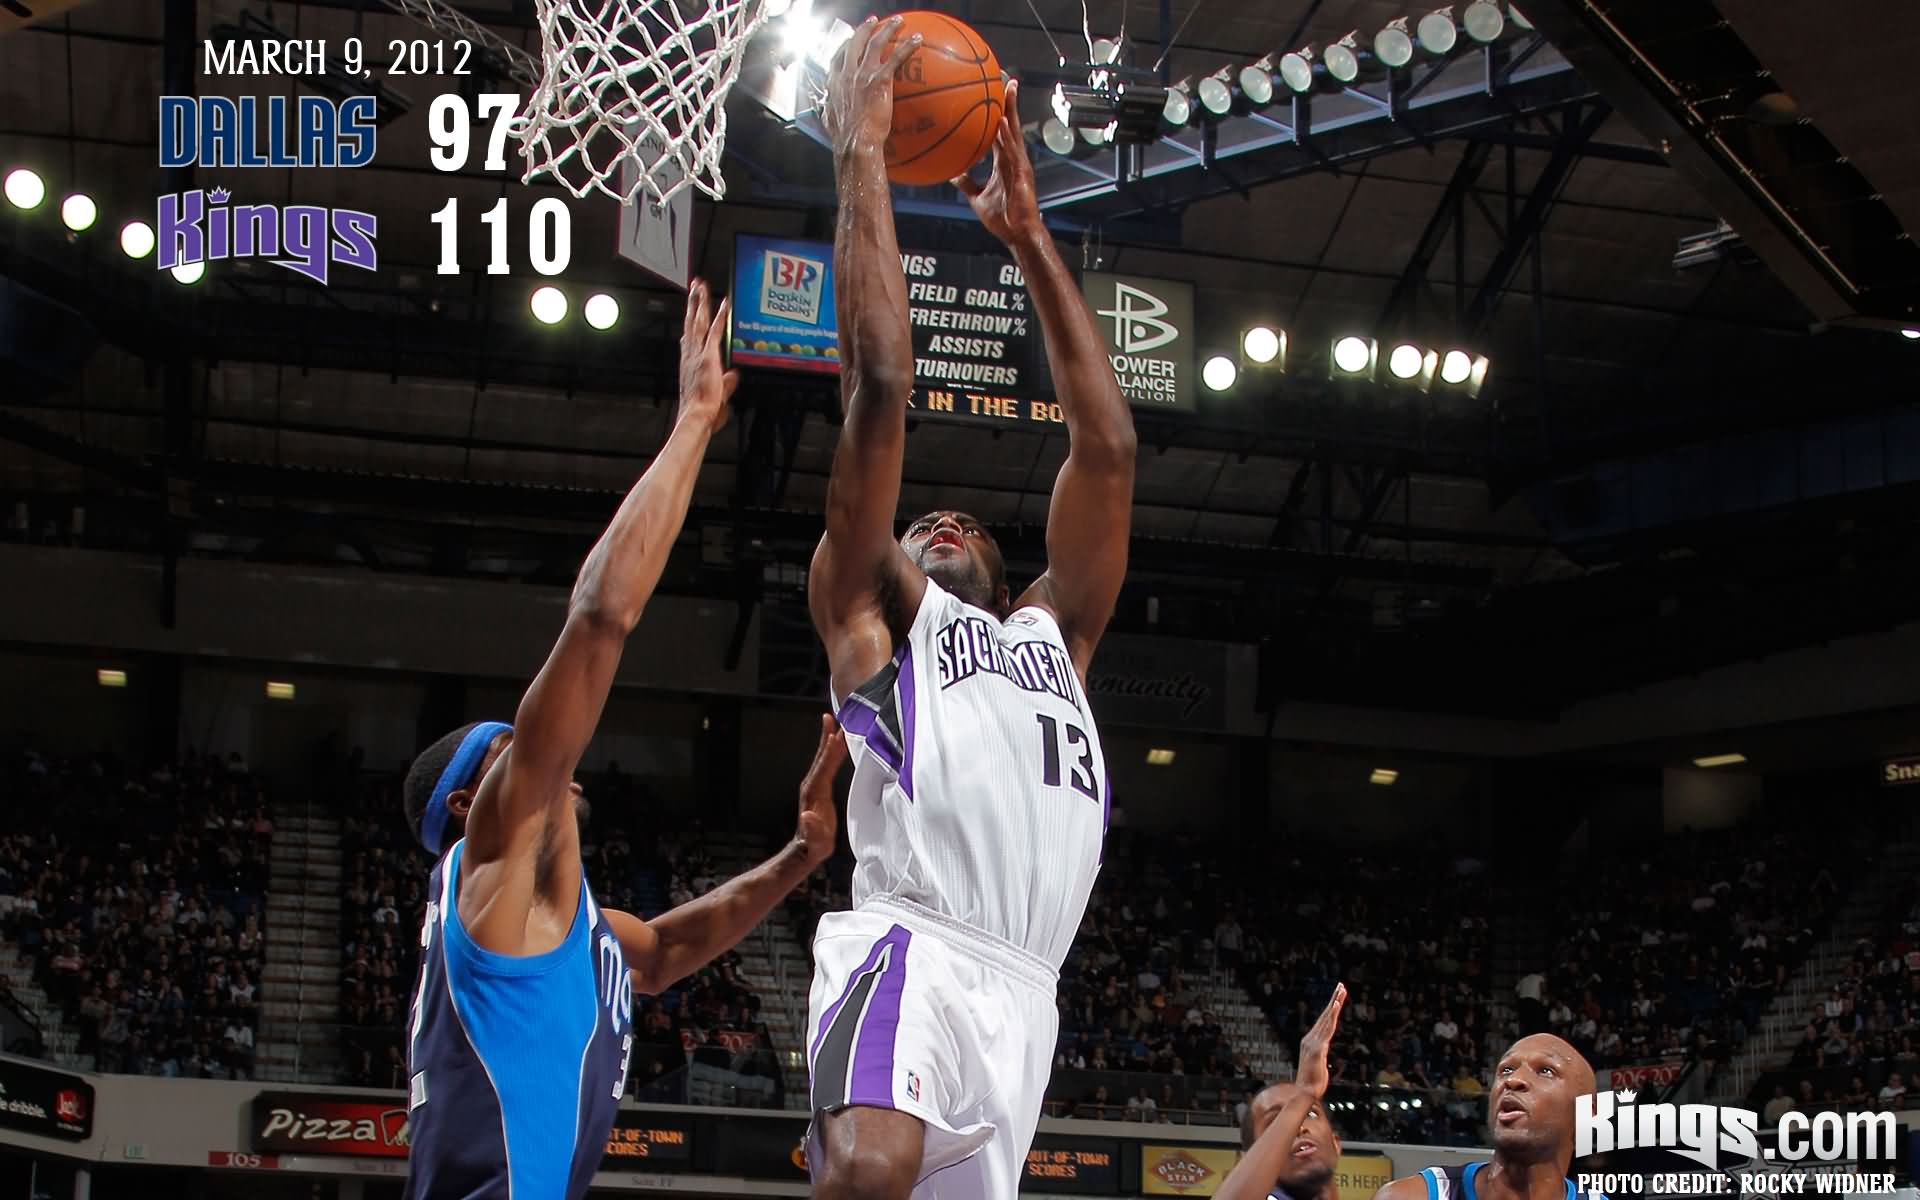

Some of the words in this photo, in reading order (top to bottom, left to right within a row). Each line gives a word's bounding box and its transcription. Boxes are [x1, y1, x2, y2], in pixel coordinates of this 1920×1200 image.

[909, 282, 957, 303] FIELD
[964, 289, 1008, 310] GOAL
[928, 335, 1004, 358] ASSISTS
[915, 358, 1018, 385] TURNOVERS
[1108, 355, 1175, 377] OWER
[927, 389, 954, 412] IN
[966, 394, 1019, 418] THE
[1036, 713, 1098, 803] 13
[261, 1108, 376, 1140] Pizza
[226, 1153, 262, 1168] 105
[1028, 1162, 1077, 1177] SCORES
[1158, 1161, 1205, 1177] BLACK
[1168, 1174, 1195, 1183] STAR
